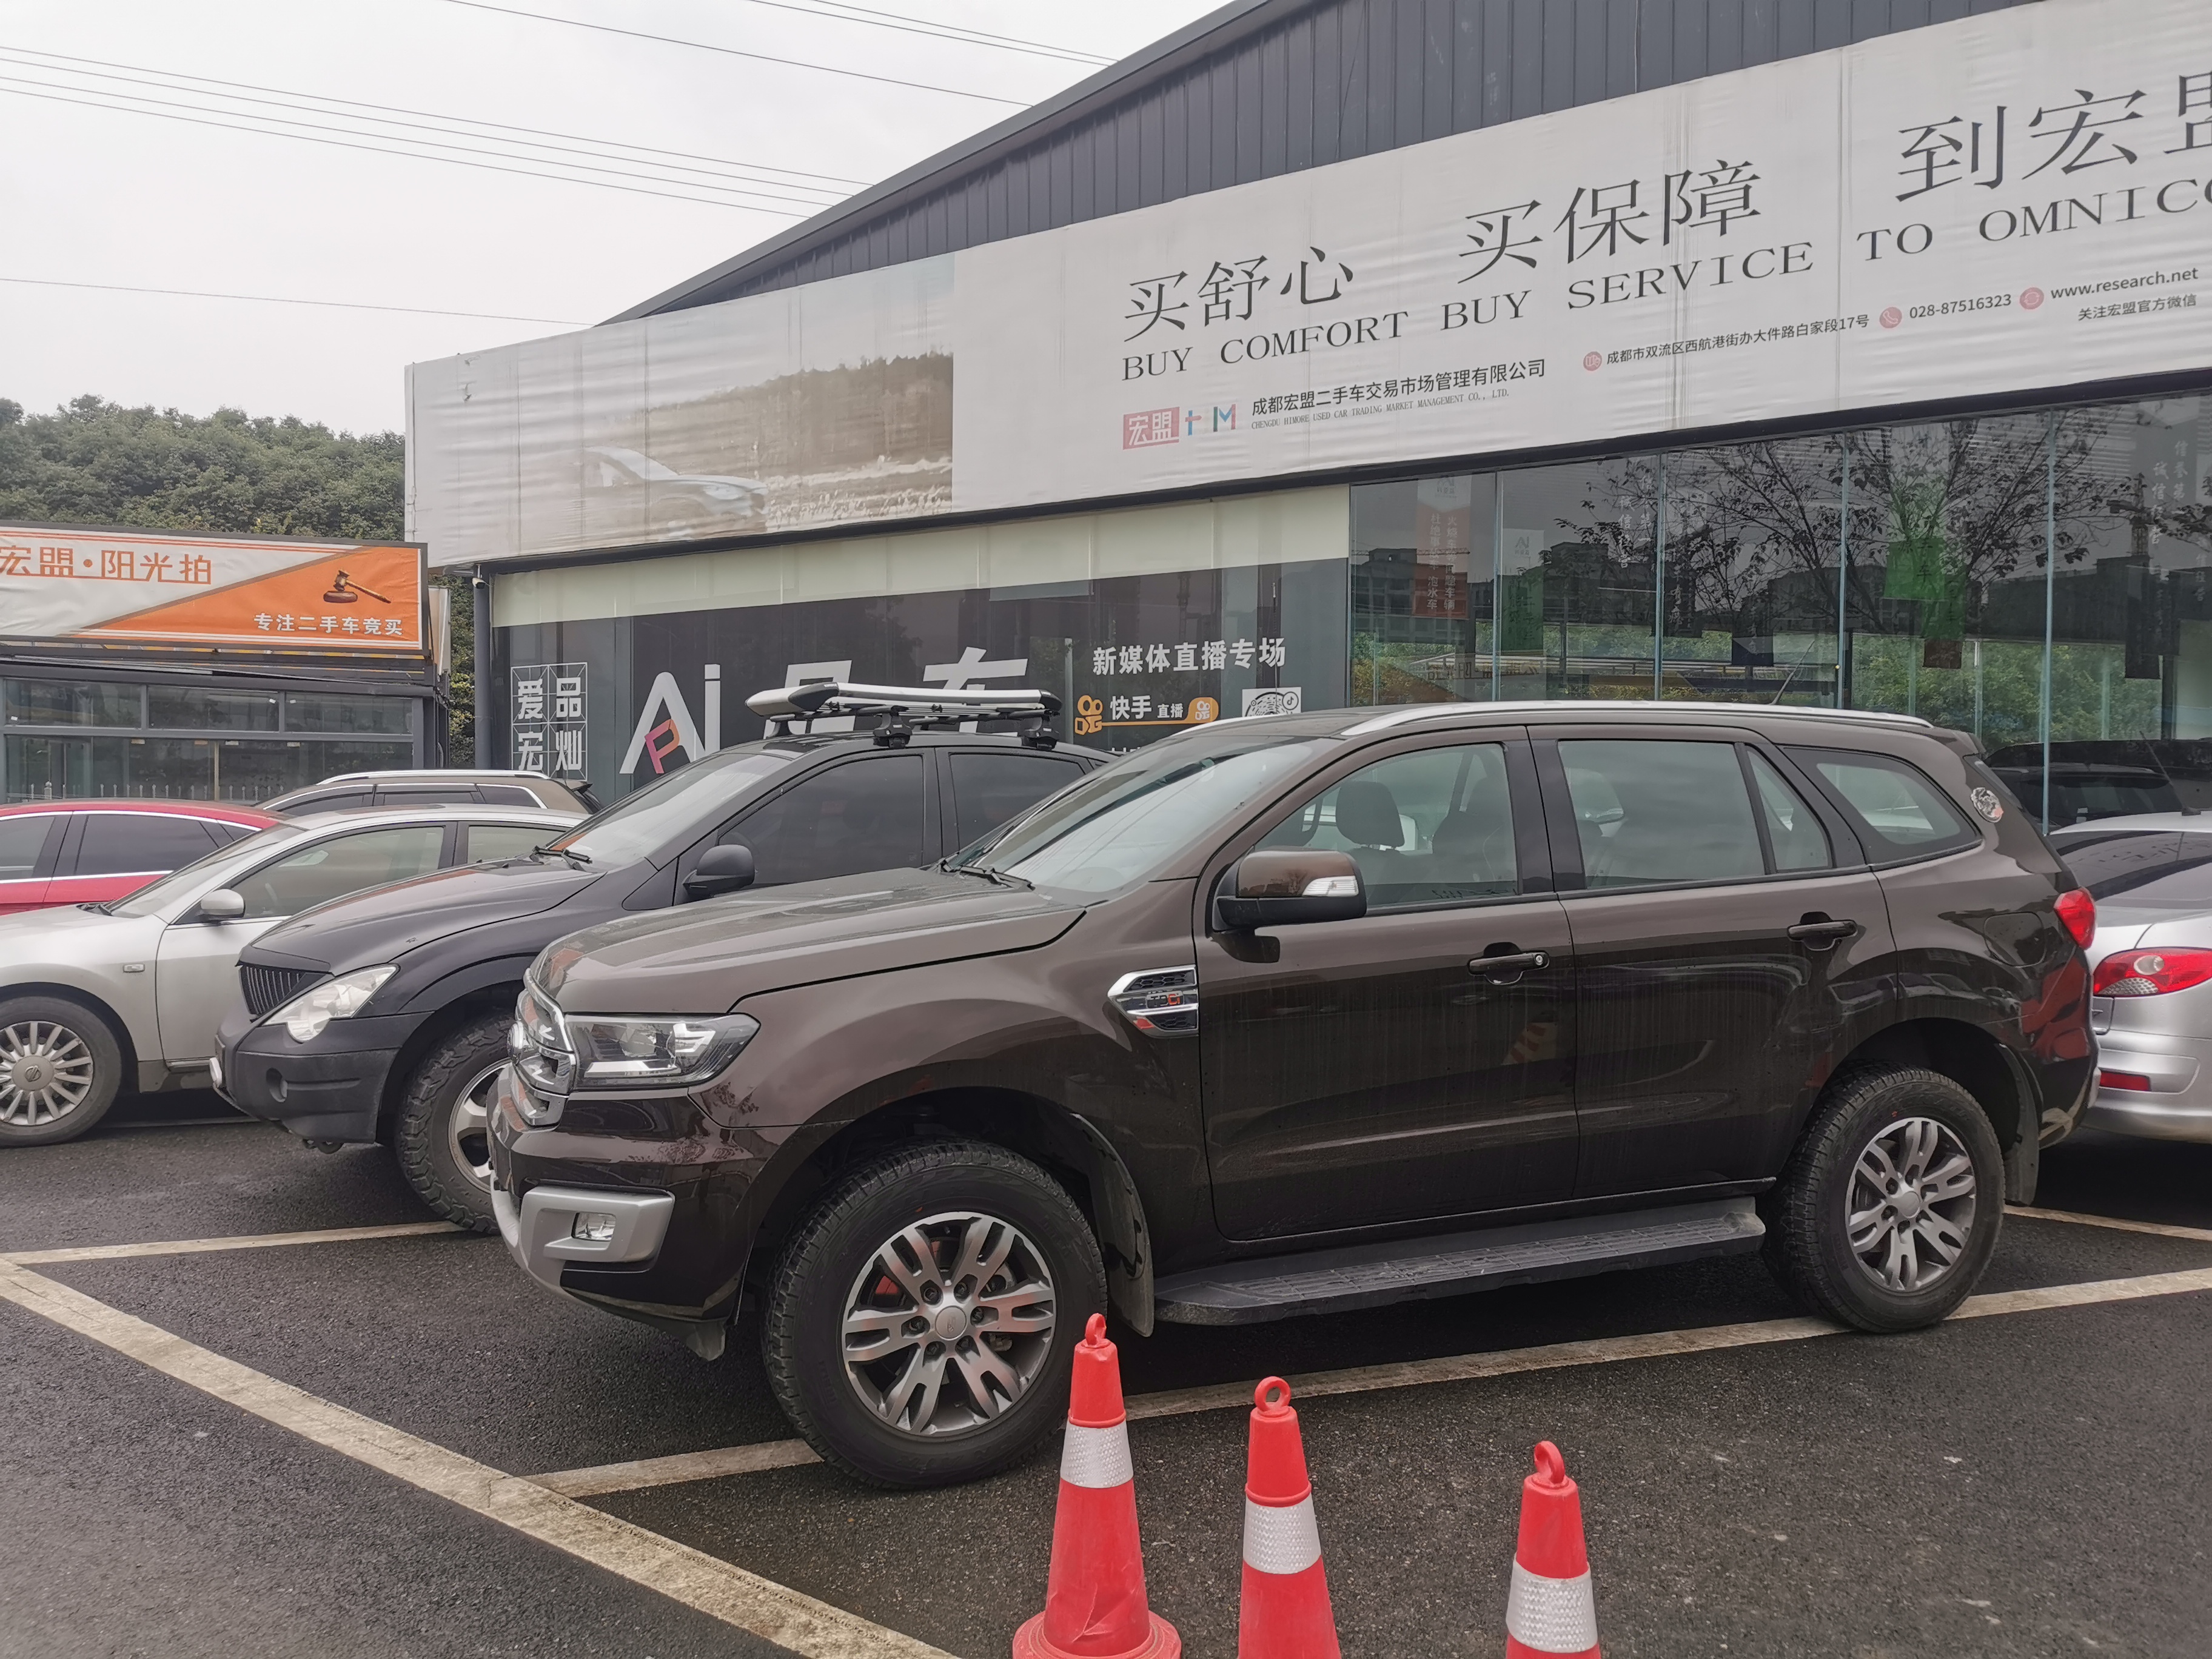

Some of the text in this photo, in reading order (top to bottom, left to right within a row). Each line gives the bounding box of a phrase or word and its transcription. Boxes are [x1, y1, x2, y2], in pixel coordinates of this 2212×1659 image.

[1124, 246, 1353, 342] 买舒心
[1457, 159, 1761, 283] 买保障
[1122, 178, 2212, 381] BUY COMFORT BUY SERVICE TO OMNIC
[2050, 267, 2199, 299] www.research.net
[1909, 293, 2013, 319] 028-87516323
[2078, 293, 2198, 321] 关注宏盟官方微信
[1252, 359, 1544, 416] 成都宏盟二手车交易市场管理有限公司
[1127, 410, 1179, 447] 宏盟
[1252, 418, 1281, 430] CHENGDU
[1313, 411, 1331, 421] USED
[1334, 409, 1348, 419] CAR
[1352, 404, 1382, 417] TRADING
[1386, 401, 1413, 412] MARKET
[1418, 394, 1464, 408] MANAGEMENT
[253, 612, 403, 636] 专注二手车竞买
[1093, 637, 1285, 676] 新媒体直播专场
[1110, 695, 1184, 720] 快手 直播
